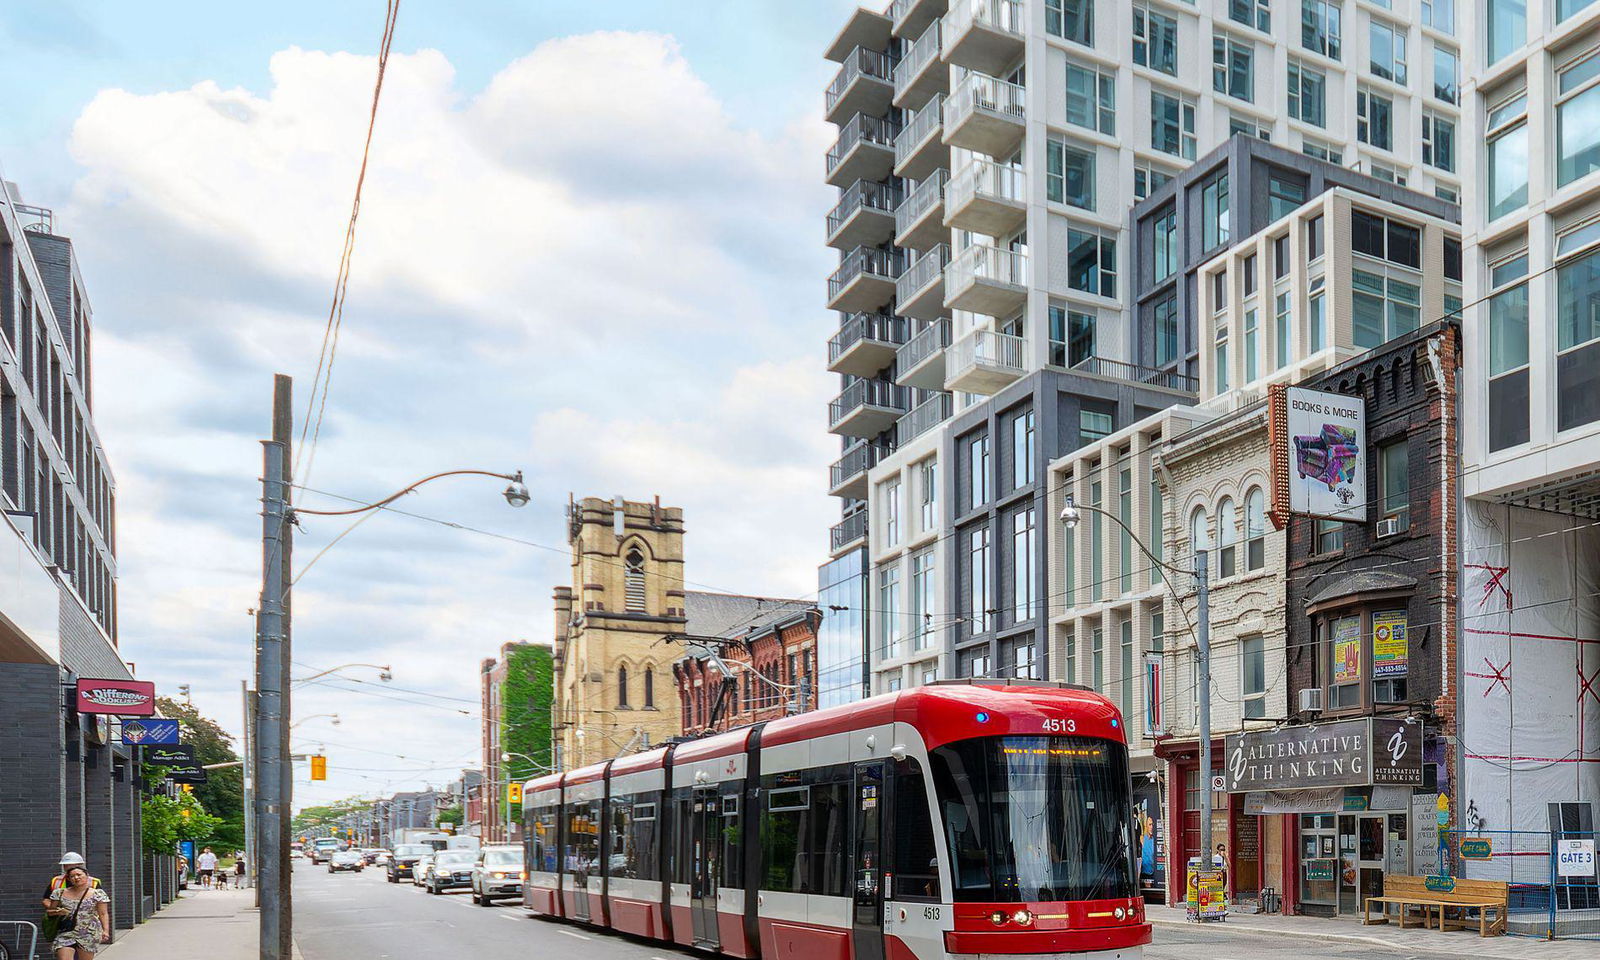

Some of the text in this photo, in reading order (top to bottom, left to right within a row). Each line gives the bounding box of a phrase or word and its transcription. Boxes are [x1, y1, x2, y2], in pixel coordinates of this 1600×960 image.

[1292, 400, 1358, 420] BOOKS & MORE
[1042, 719, 1076, 732] 4513
[1249, 736, 1362, 760] ALTERNATIVE
[1561, 853, 1592, 863] GATE 3
[924, 907, 940, 920] 4513
